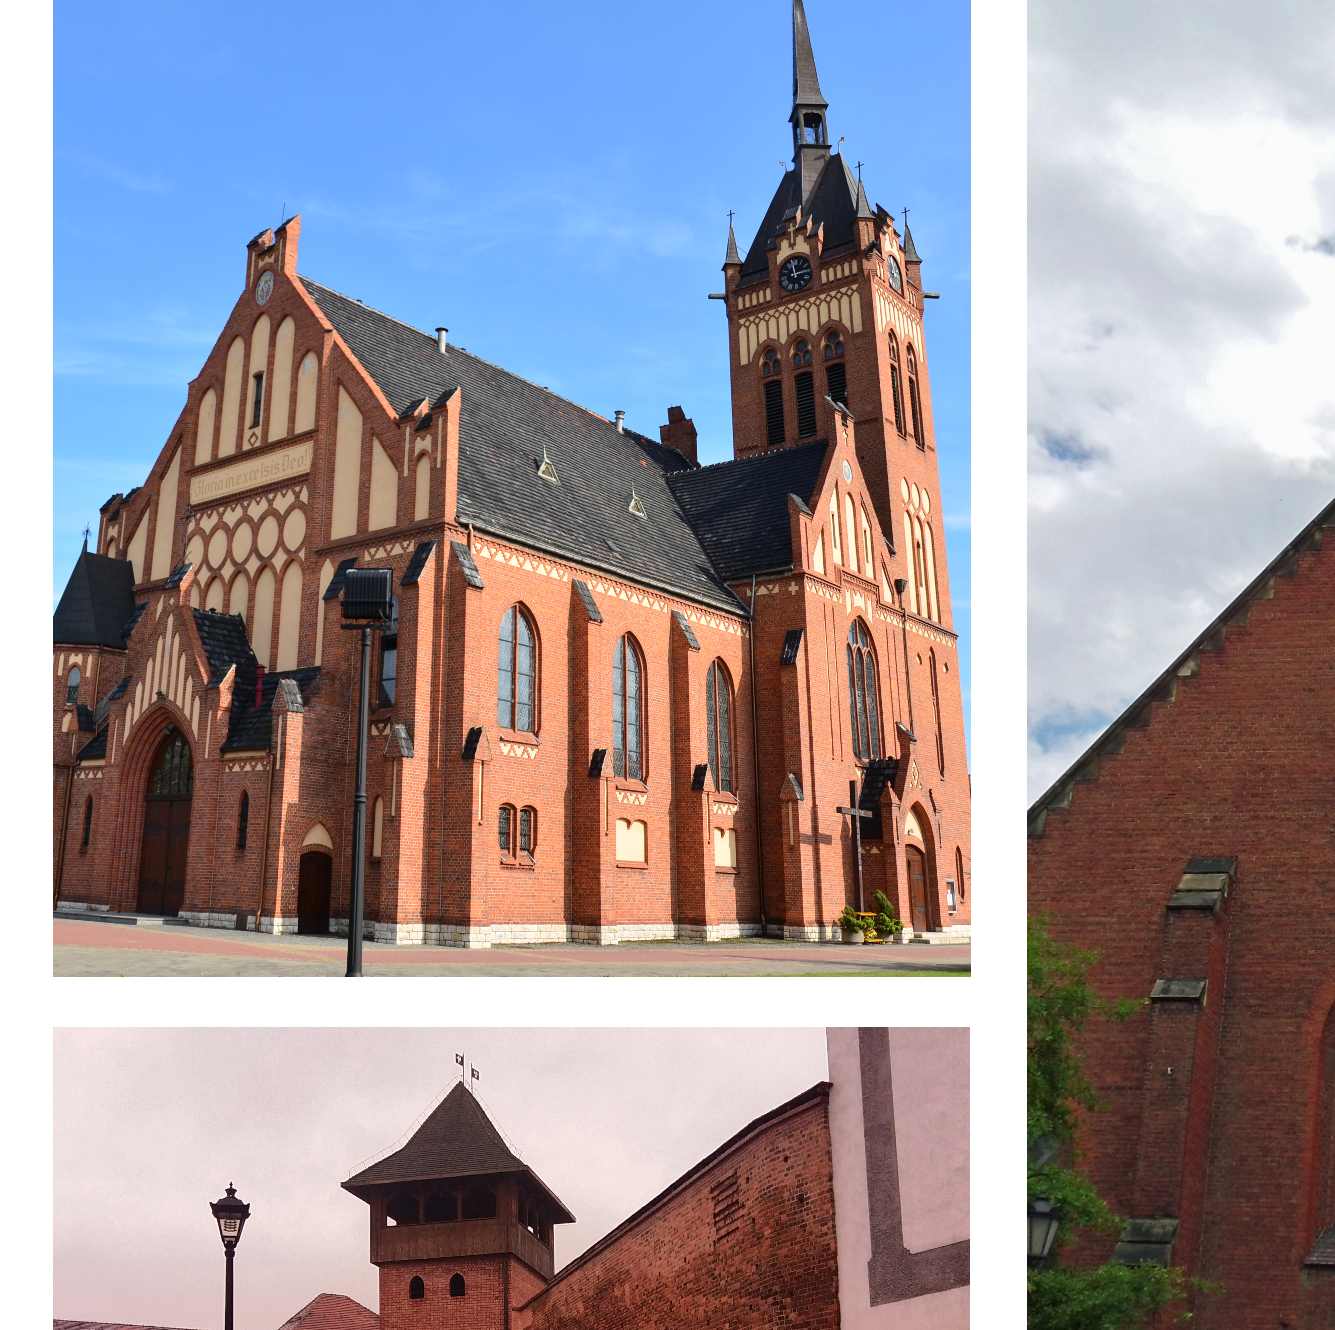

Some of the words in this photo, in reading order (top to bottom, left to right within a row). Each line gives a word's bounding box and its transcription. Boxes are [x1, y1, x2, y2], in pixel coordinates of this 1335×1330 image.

[194, 477, 224, 498] Gloria
[225, 473, 235, 488] in
[236, 459, 281, 487] excelsis
